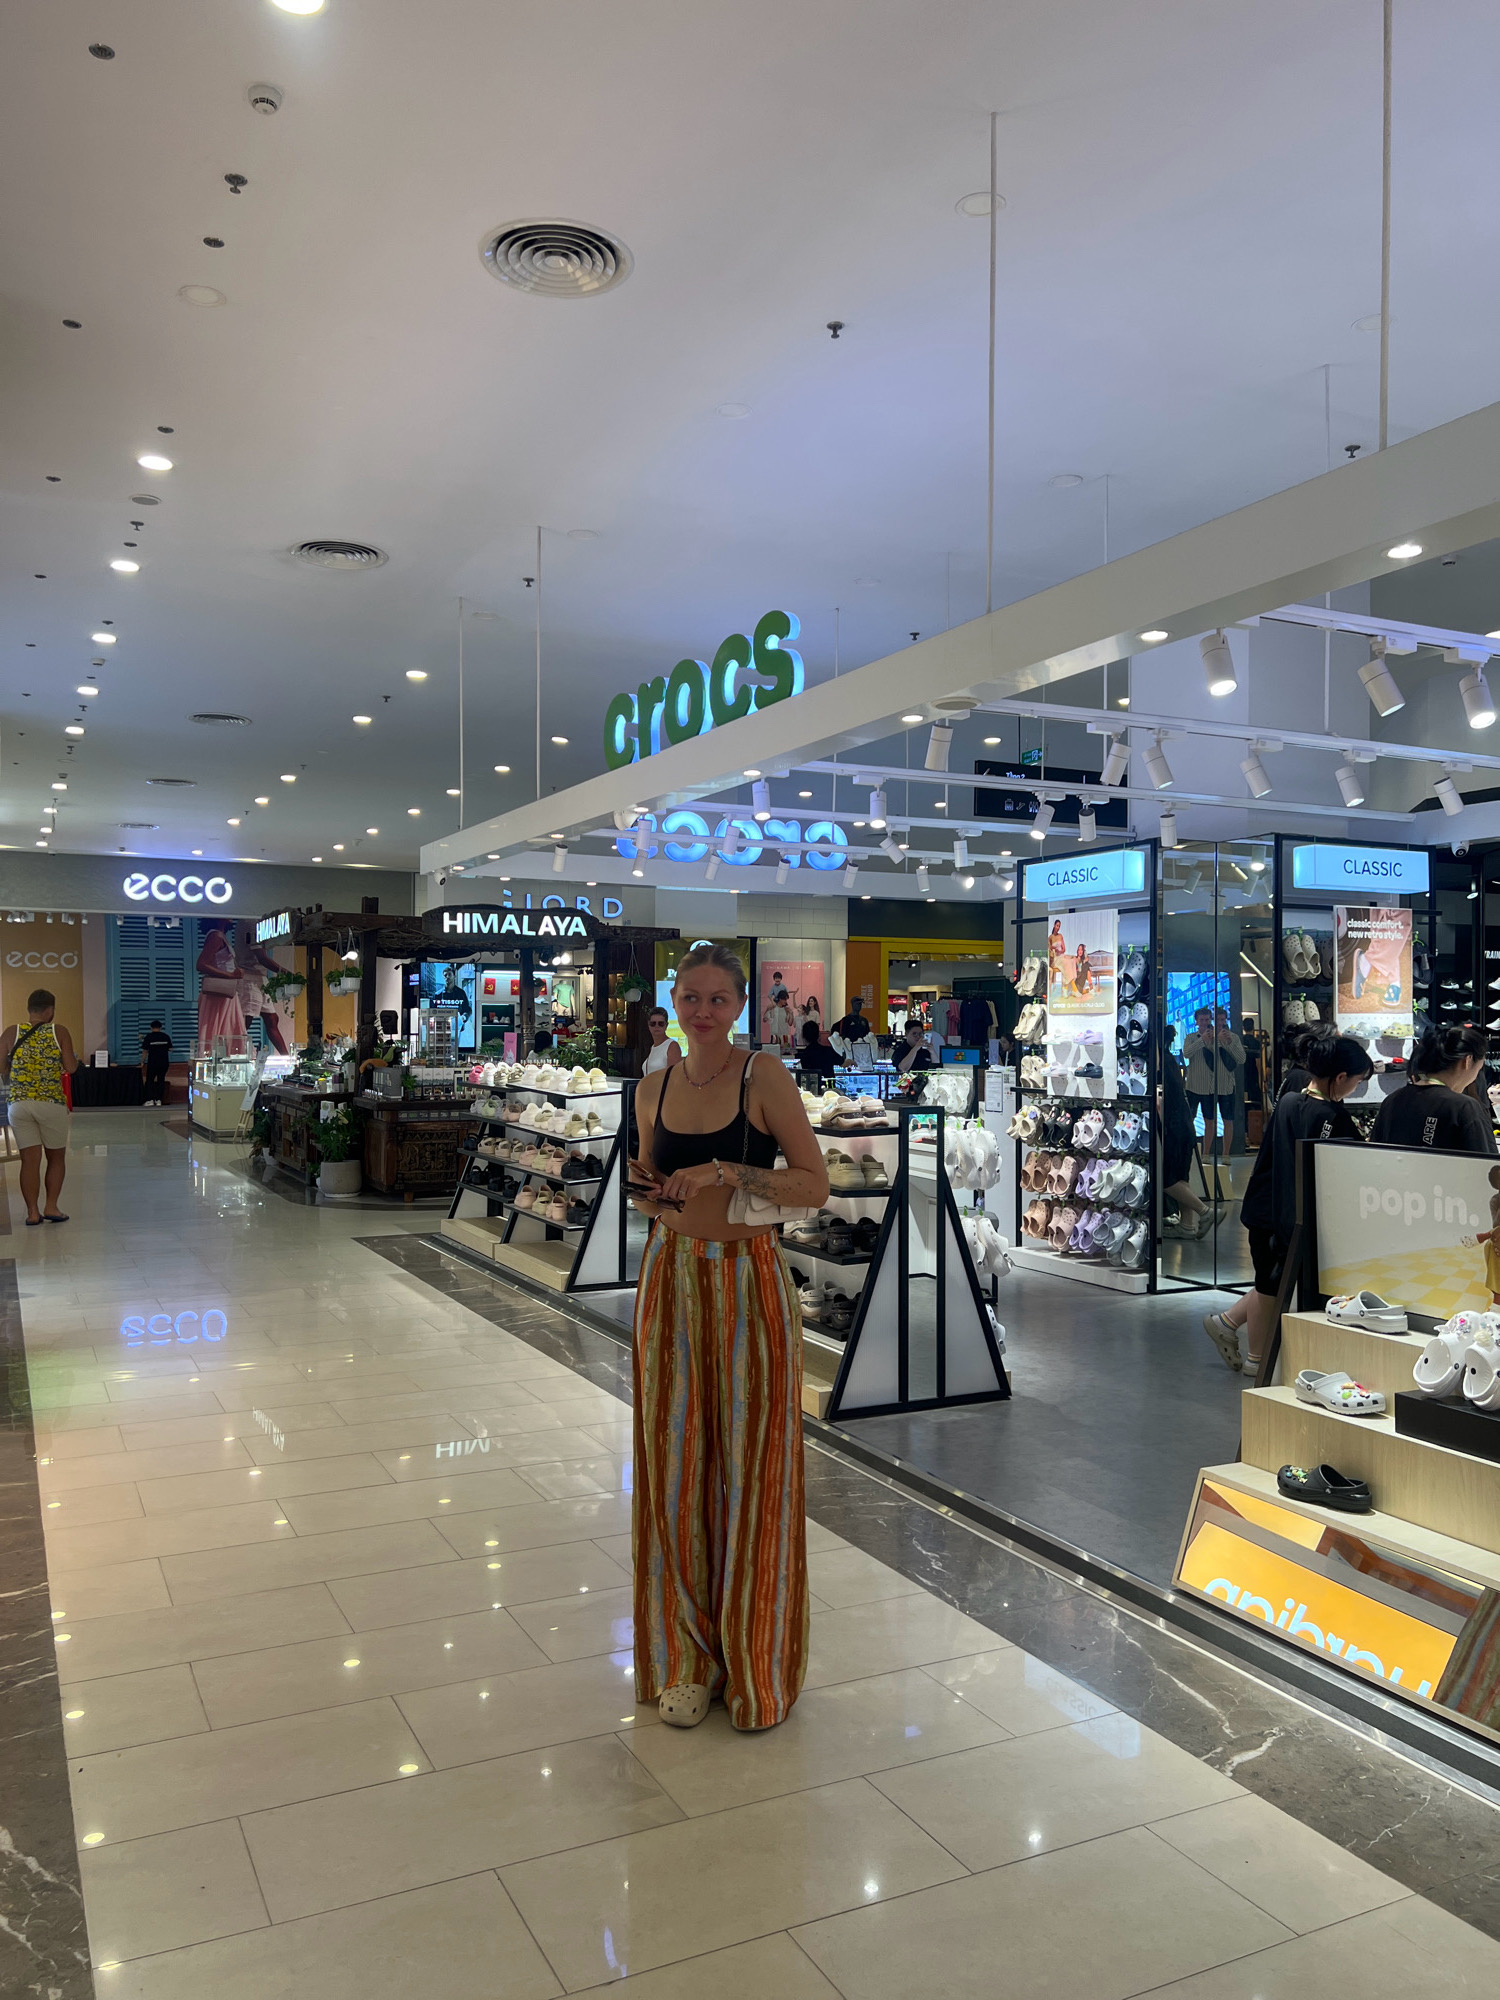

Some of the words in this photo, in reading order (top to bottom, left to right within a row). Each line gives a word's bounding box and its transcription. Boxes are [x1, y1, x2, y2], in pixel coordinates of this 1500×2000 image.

[604, 610, 805, 771] crocs
[1047, 866, 1099, 887] CLASSIC
[1343, 859, 1402, 877] CLASSIC
[123, 872, 233, 904] ecco
[256, 911, 290, 943] HIMALAYA
[443, 912, 587, 937] HIMALAYA
[1347, 918, 1371, 928] classic
[1372, 919, 1404, 929] comfort.
[1348, 930, 1363, 939] new
[1364, 930, 1383, 939] retro
[1384, 930, 1404, 941] style.
[5, 950, 79, 969] ecco
[1319, 1122, 1333, 1139] RE
[1359, 1186, 1427, 1226] pop
[1433, 1184, 1480, 1227] in.
